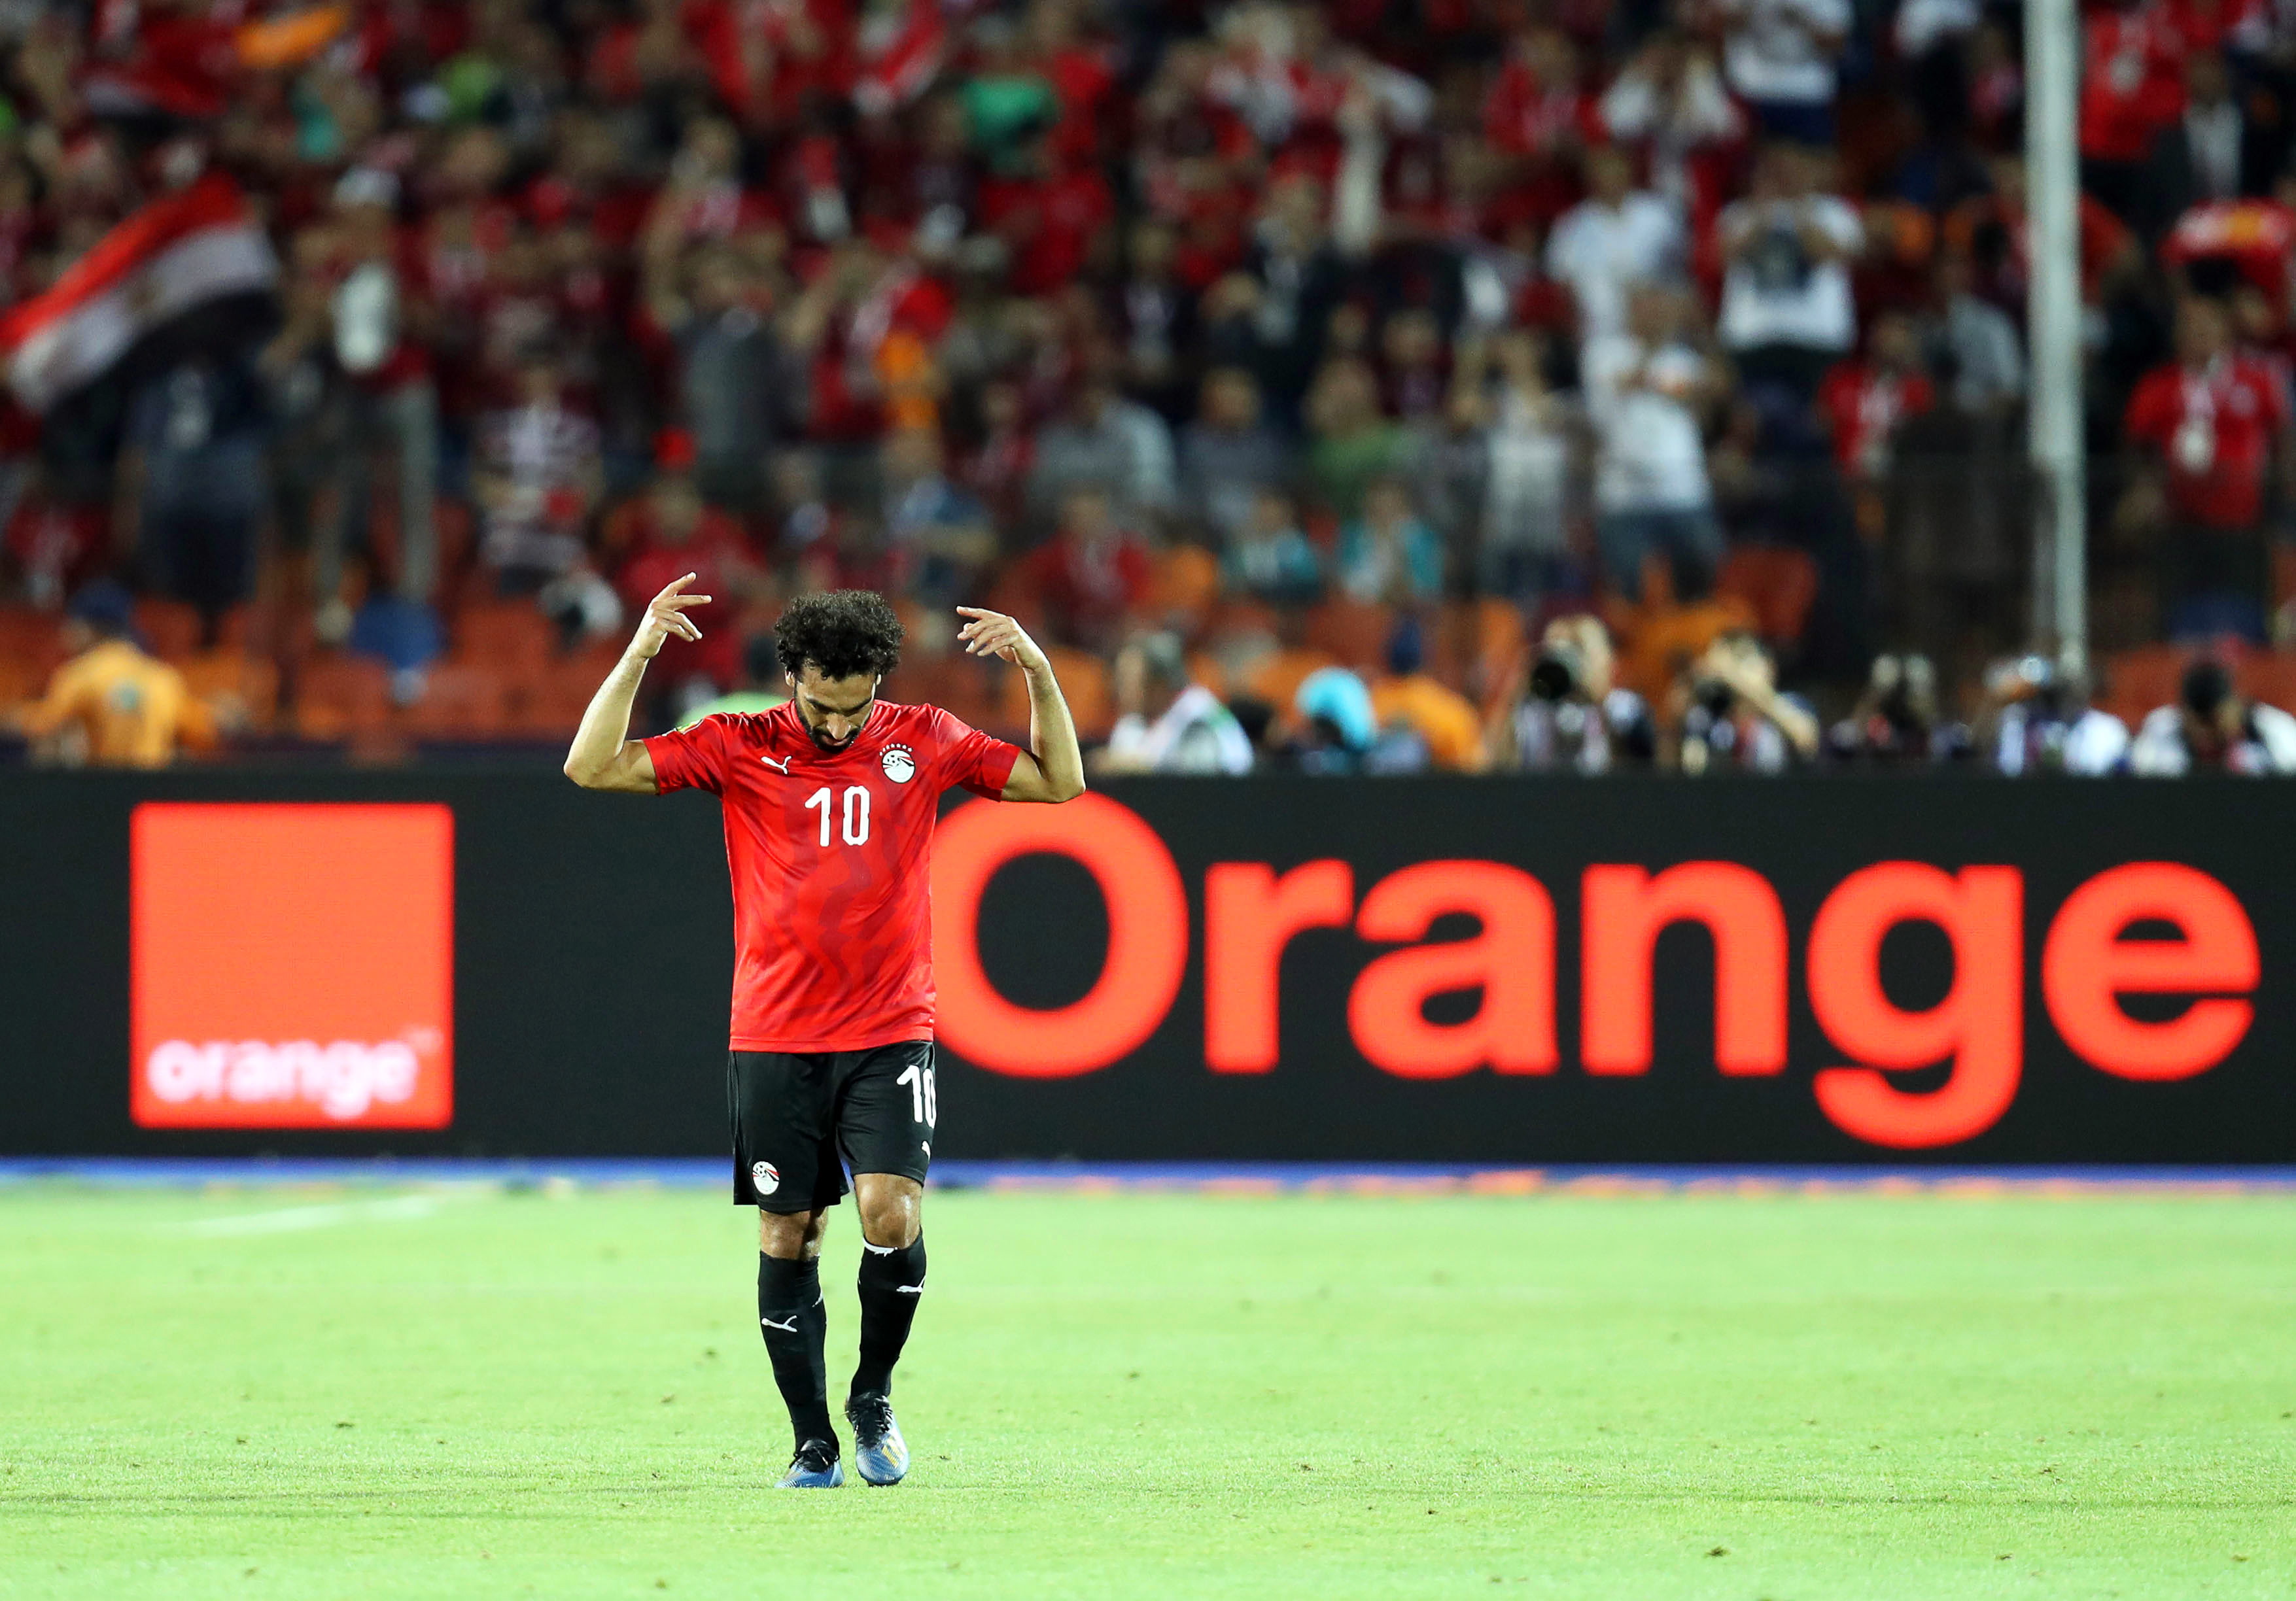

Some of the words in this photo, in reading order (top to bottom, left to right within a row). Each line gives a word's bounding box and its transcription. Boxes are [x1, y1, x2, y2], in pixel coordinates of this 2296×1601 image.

[805, 785, 871, 847] 10
[932, 792, 2261, 1148] Orange
[147, 1039, 419, 1120] orange
[896, 1064, 937, 1129] 10
